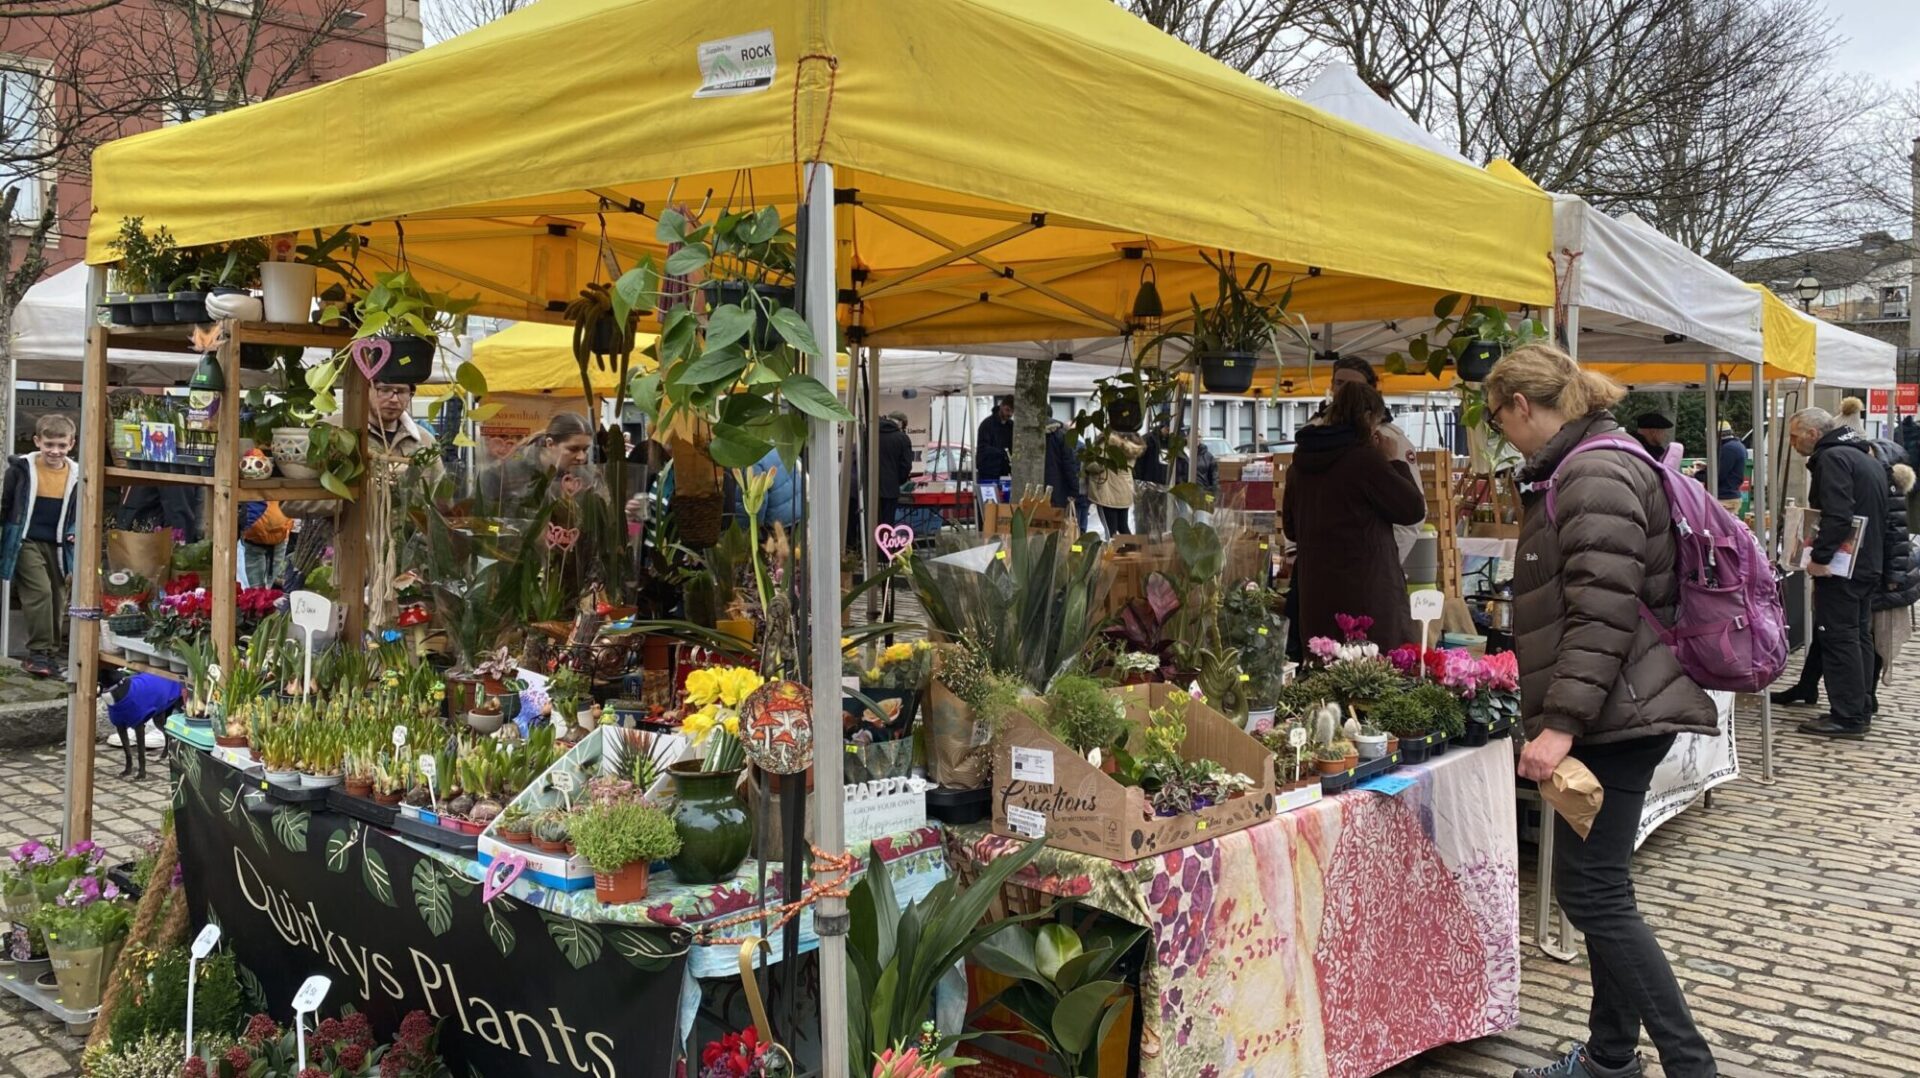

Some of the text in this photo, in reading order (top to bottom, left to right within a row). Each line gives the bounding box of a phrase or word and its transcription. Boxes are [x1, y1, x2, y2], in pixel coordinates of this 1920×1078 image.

[741, 44, 772, 61] ROCK
[882, 531, 907, 548] love
[843, 776, 909, 803] HAPPY
[1028, 784, 1053, 795] PLANT
[853, 799, 916, 815] GROW YOUR OWN
[998, 779, 1097, 821] Creations
[233, 846, 616, 1078] Quirkys Plants
